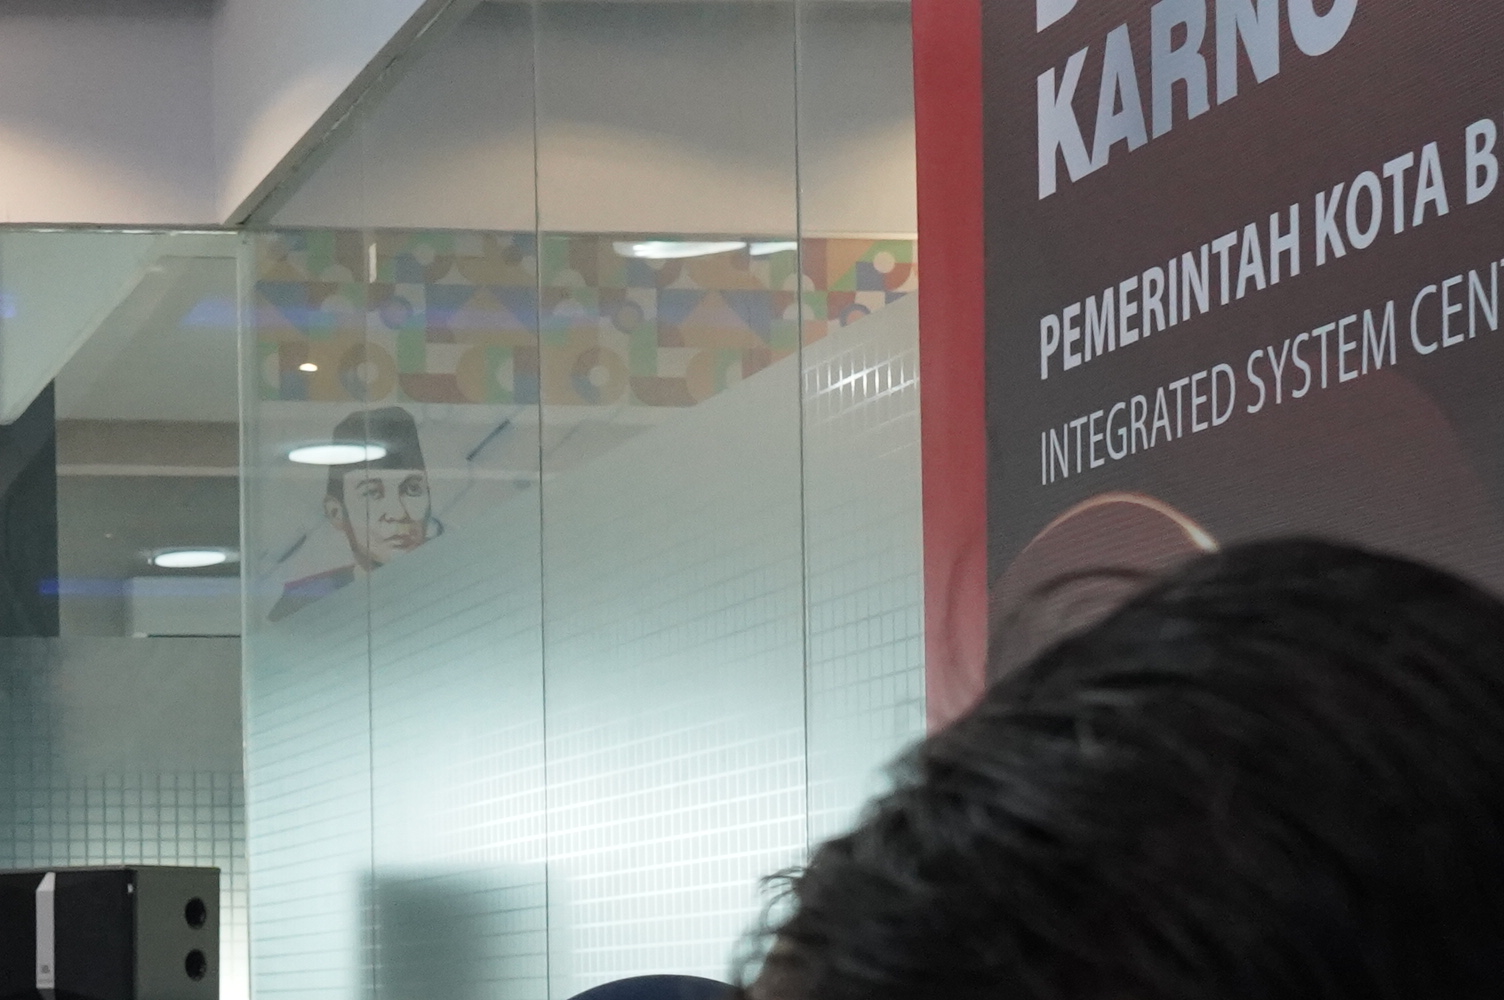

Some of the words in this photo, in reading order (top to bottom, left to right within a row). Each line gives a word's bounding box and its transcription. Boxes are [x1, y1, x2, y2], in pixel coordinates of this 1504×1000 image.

[1039, 203, 1301, 381] PEMERINTAH
[1315, 141, 1450, 267] KOTA
[1041, 363, 1237, 486] INTEGRATED
[1246, 300, 1398, 415] SYSTEM
[1409, 257, 1504, 356] CEN
